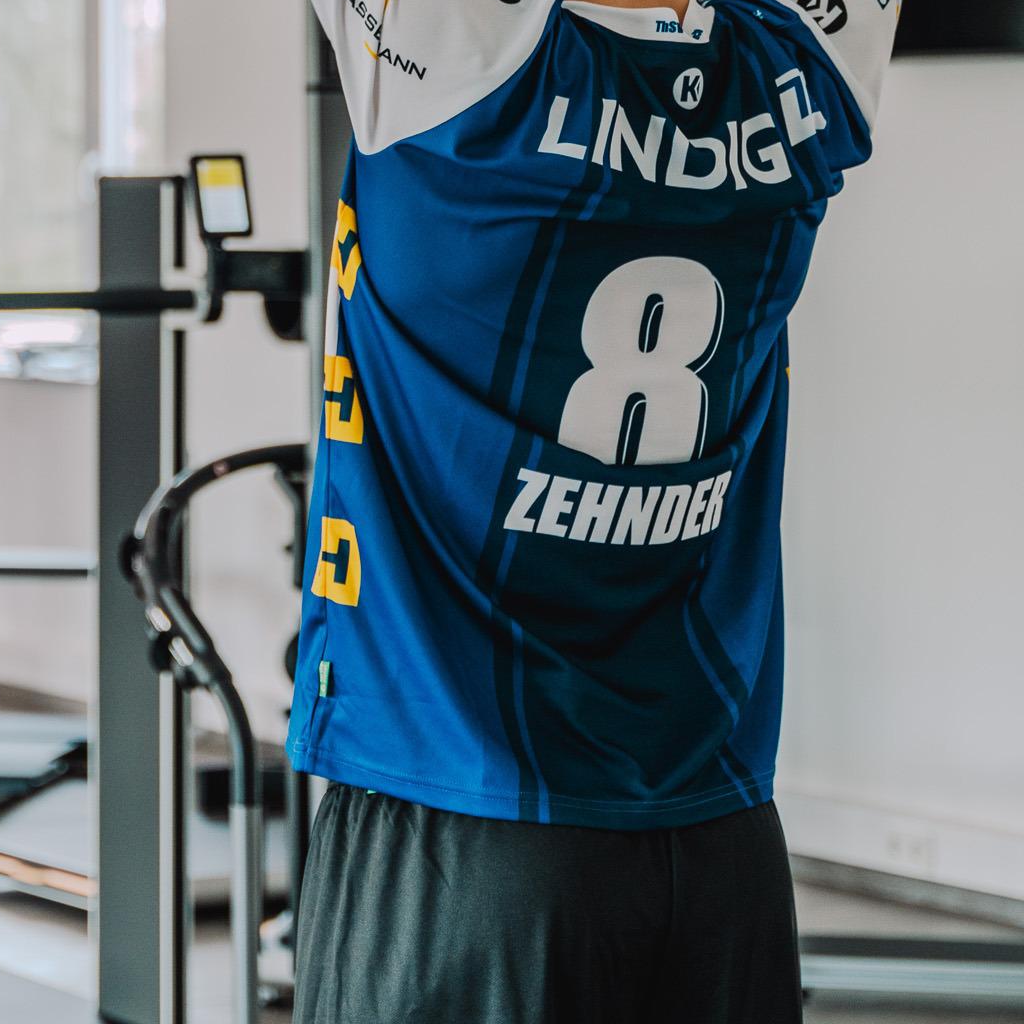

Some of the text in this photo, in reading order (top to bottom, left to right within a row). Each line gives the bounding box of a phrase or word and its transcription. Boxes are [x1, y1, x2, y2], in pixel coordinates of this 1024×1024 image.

[537, 95, 792, 190] LINDIG
[557, 255, 725, 466] 8
[503, 467, 732, 546] ZEHNDER
